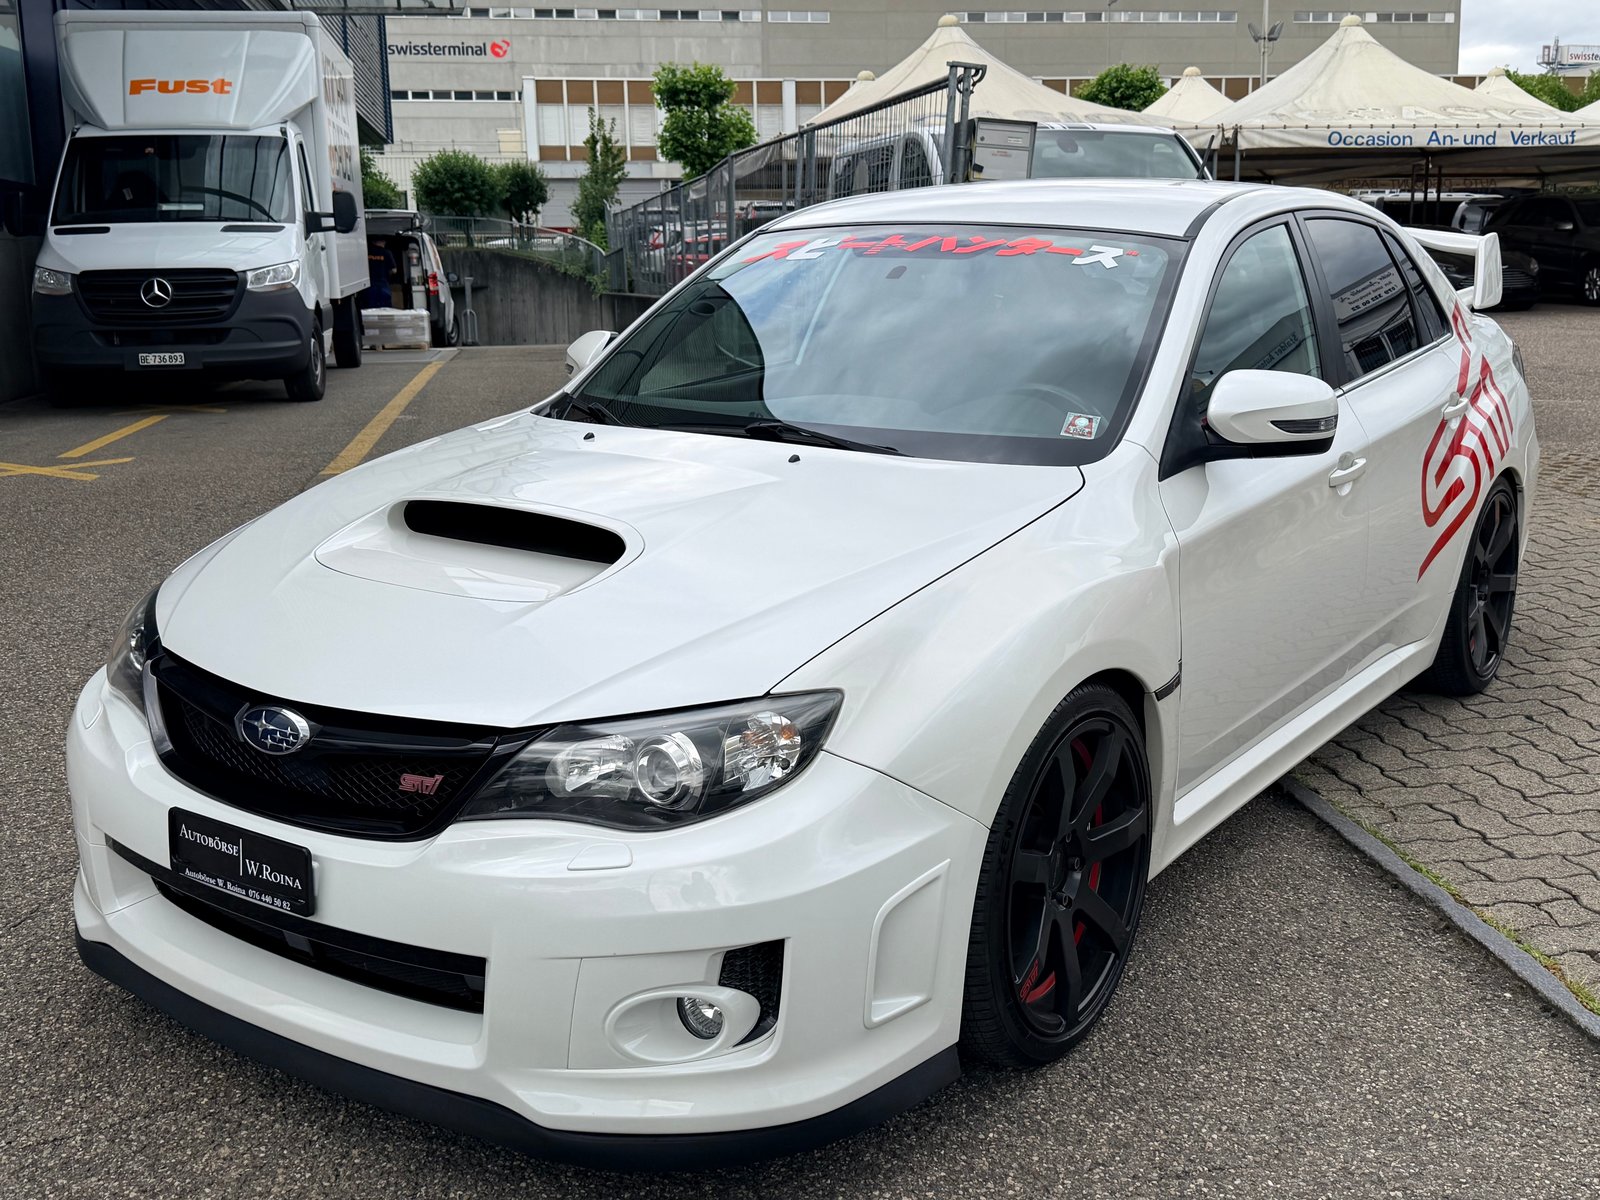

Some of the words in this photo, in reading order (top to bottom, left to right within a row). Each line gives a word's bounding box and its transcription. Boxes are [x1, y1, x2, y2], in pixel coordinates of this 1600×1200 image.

[387, 41, 487, 57] swissterminal
[1569, 51, 1600, 61] swisste
[1327, 130, 1413, 146] Occasion
[1426, 130, 1460, 146] An-
[1463, 130, 1497, 146] und
[1510, 130, 1577, 146] Verkauf
[179, 823, 239, 857] AUTOBÖRSE
[185, 867, 217, 885] Autobörse
[217, 878, 226, 889] W.
[227, 881, 246, 895] Roina
[249, 889, 260, 900] 076
[261, 893, 273, 905] 440
[274, 897, 282, 908] 50
[282, 901, 291, 911] 82
